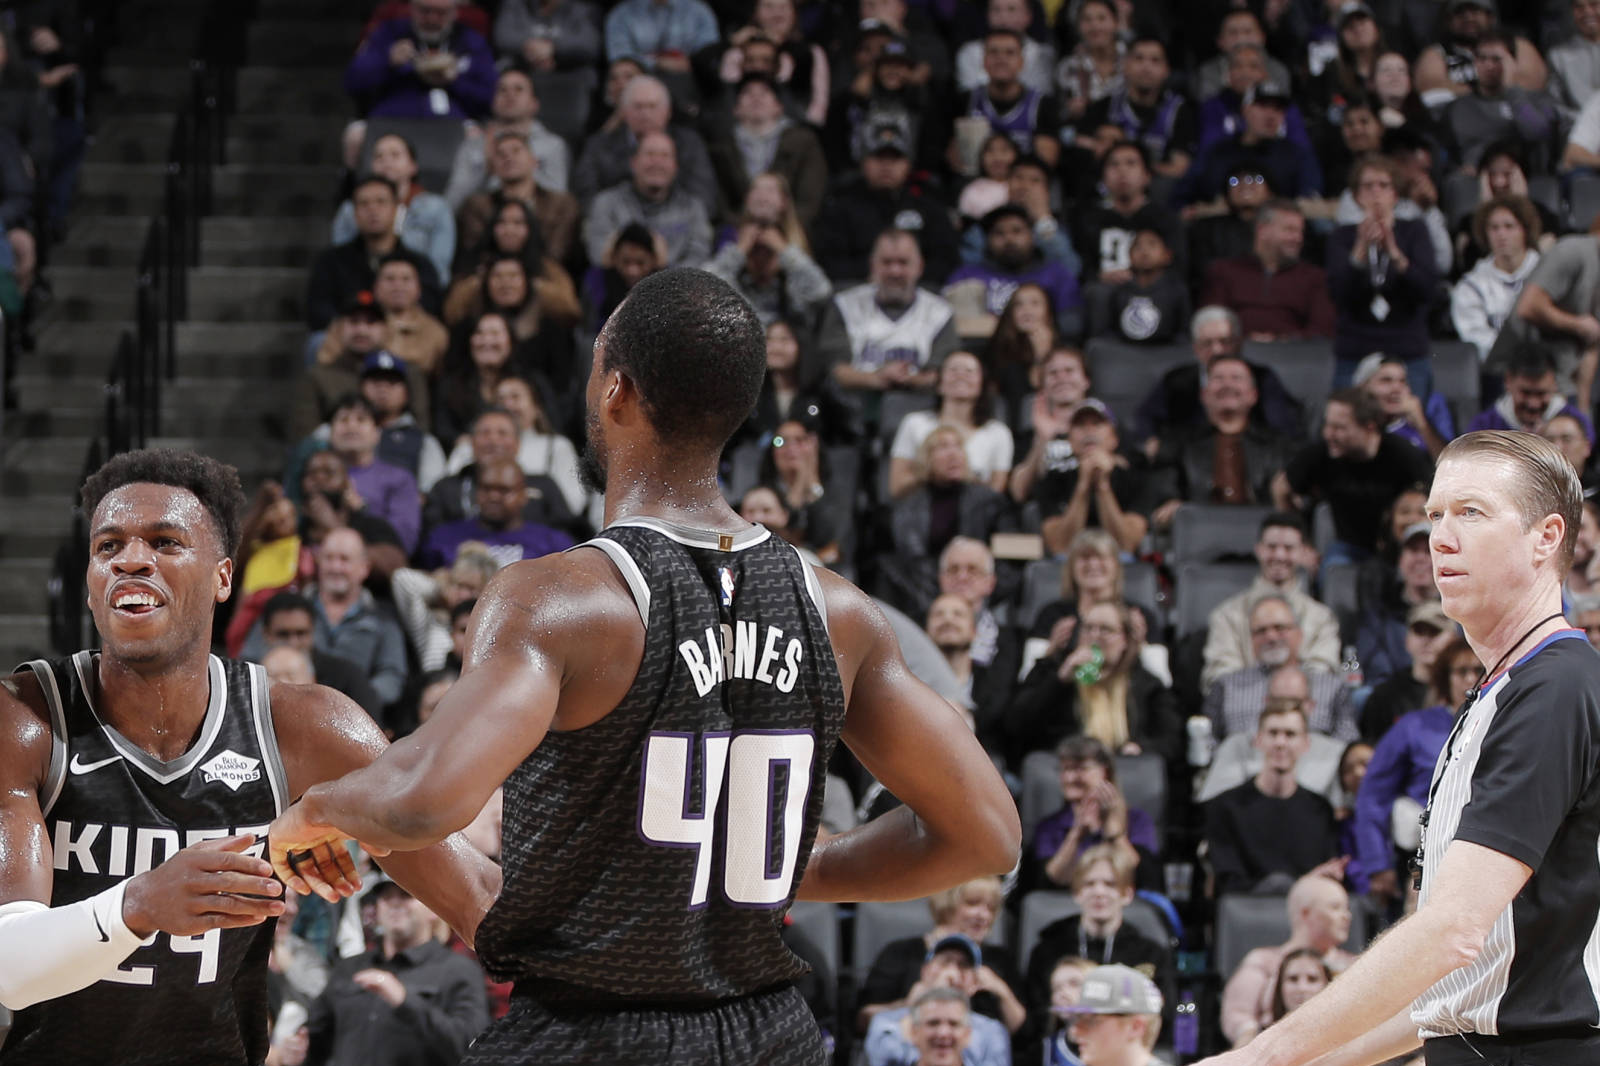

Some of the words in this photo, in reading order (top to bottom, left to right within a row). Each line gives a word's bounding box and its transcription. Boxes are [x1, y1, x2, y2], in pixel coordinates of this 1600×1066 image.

[679, 620, 802, 698] BARNES
[207, 771, 259, 780] ALMONDS
[638, 729, 816, 911] 40
